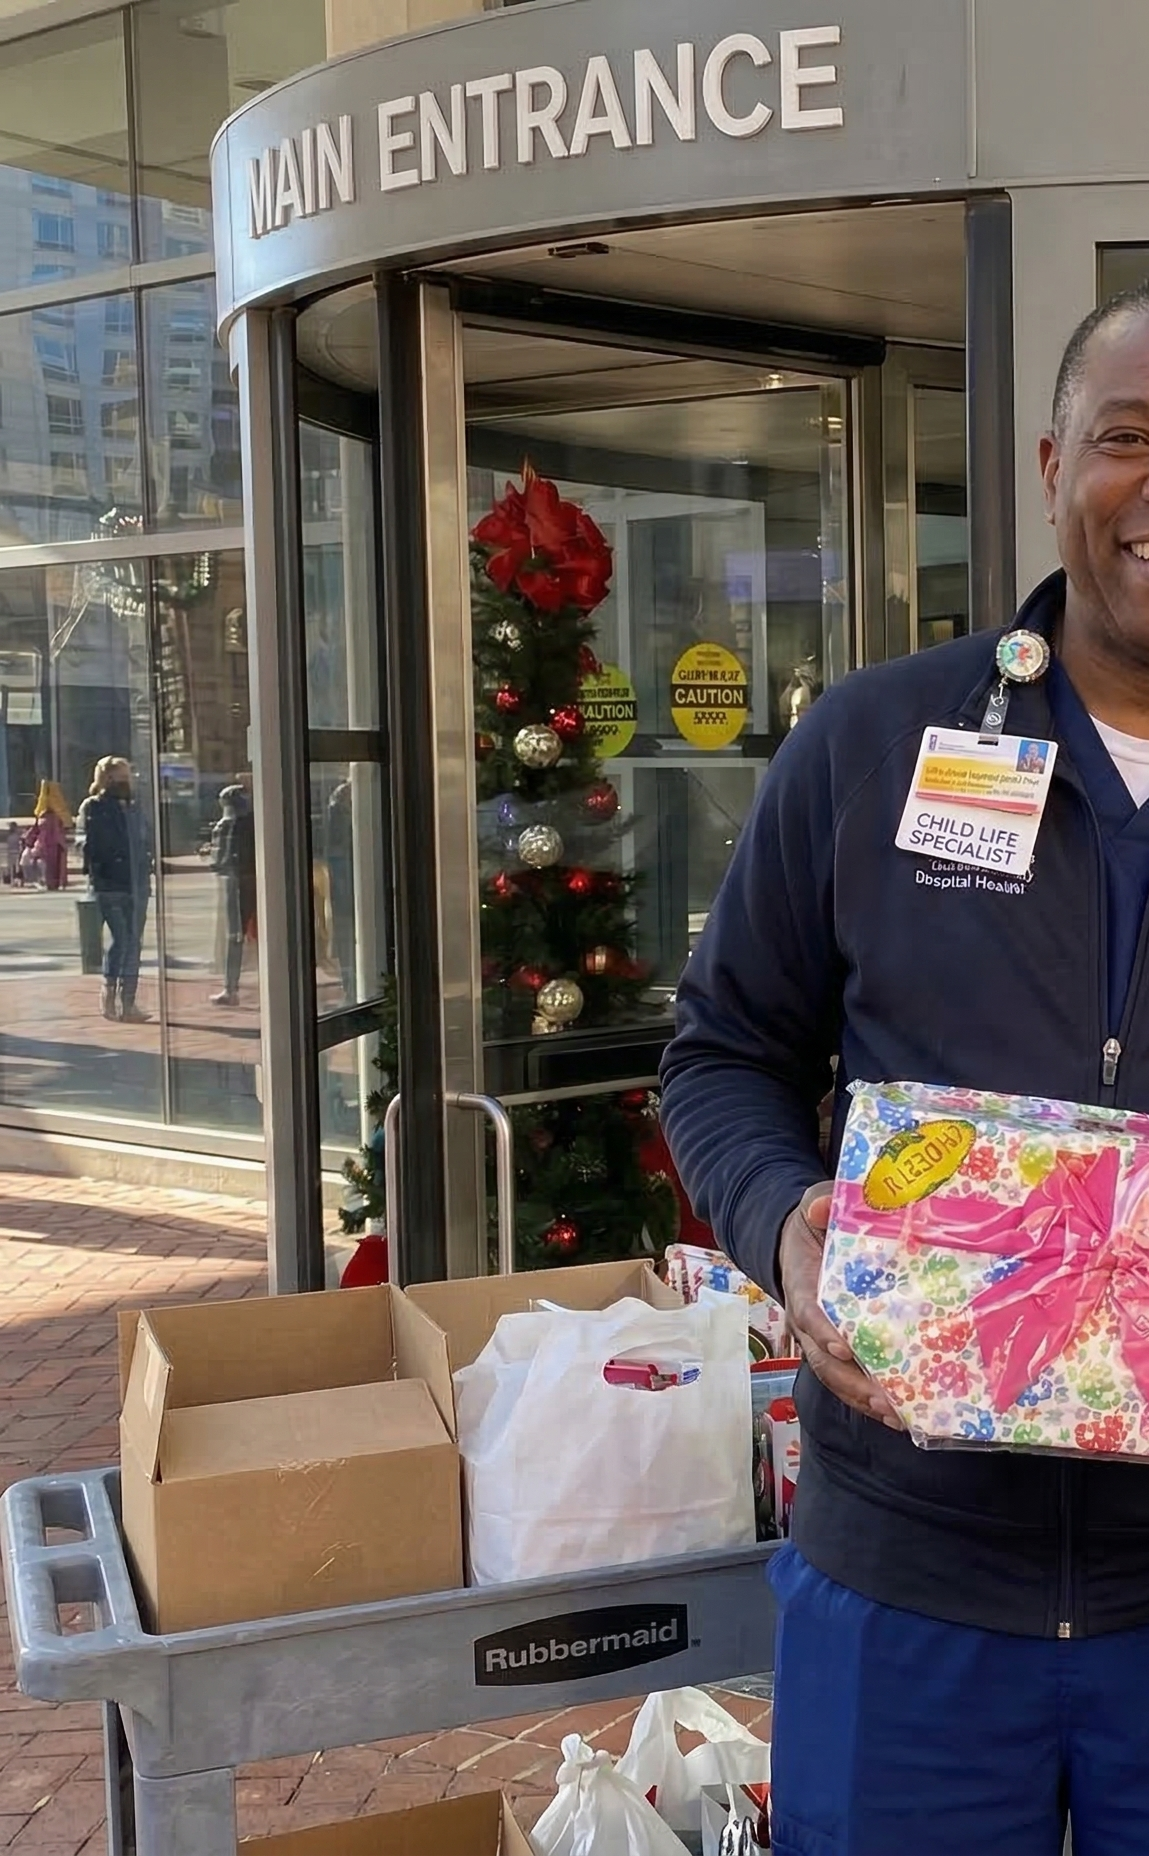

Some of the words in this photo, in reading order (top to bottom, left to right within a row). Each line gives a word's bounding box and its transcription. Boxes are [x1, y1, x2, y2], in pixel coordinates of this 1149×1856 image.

[249, 115, 356, 239] MAIN
[378, 25, 843, 192] ENTRANCE
[674, 688, 744, 704] CAUTION
[909, 829, 1016, 865] SPECIALIST
[917, 813, 974, 837] CHILD
[979, 827, 1020, 848] LIFE
[485, 1618, 678, 1673] Rubbermaid
